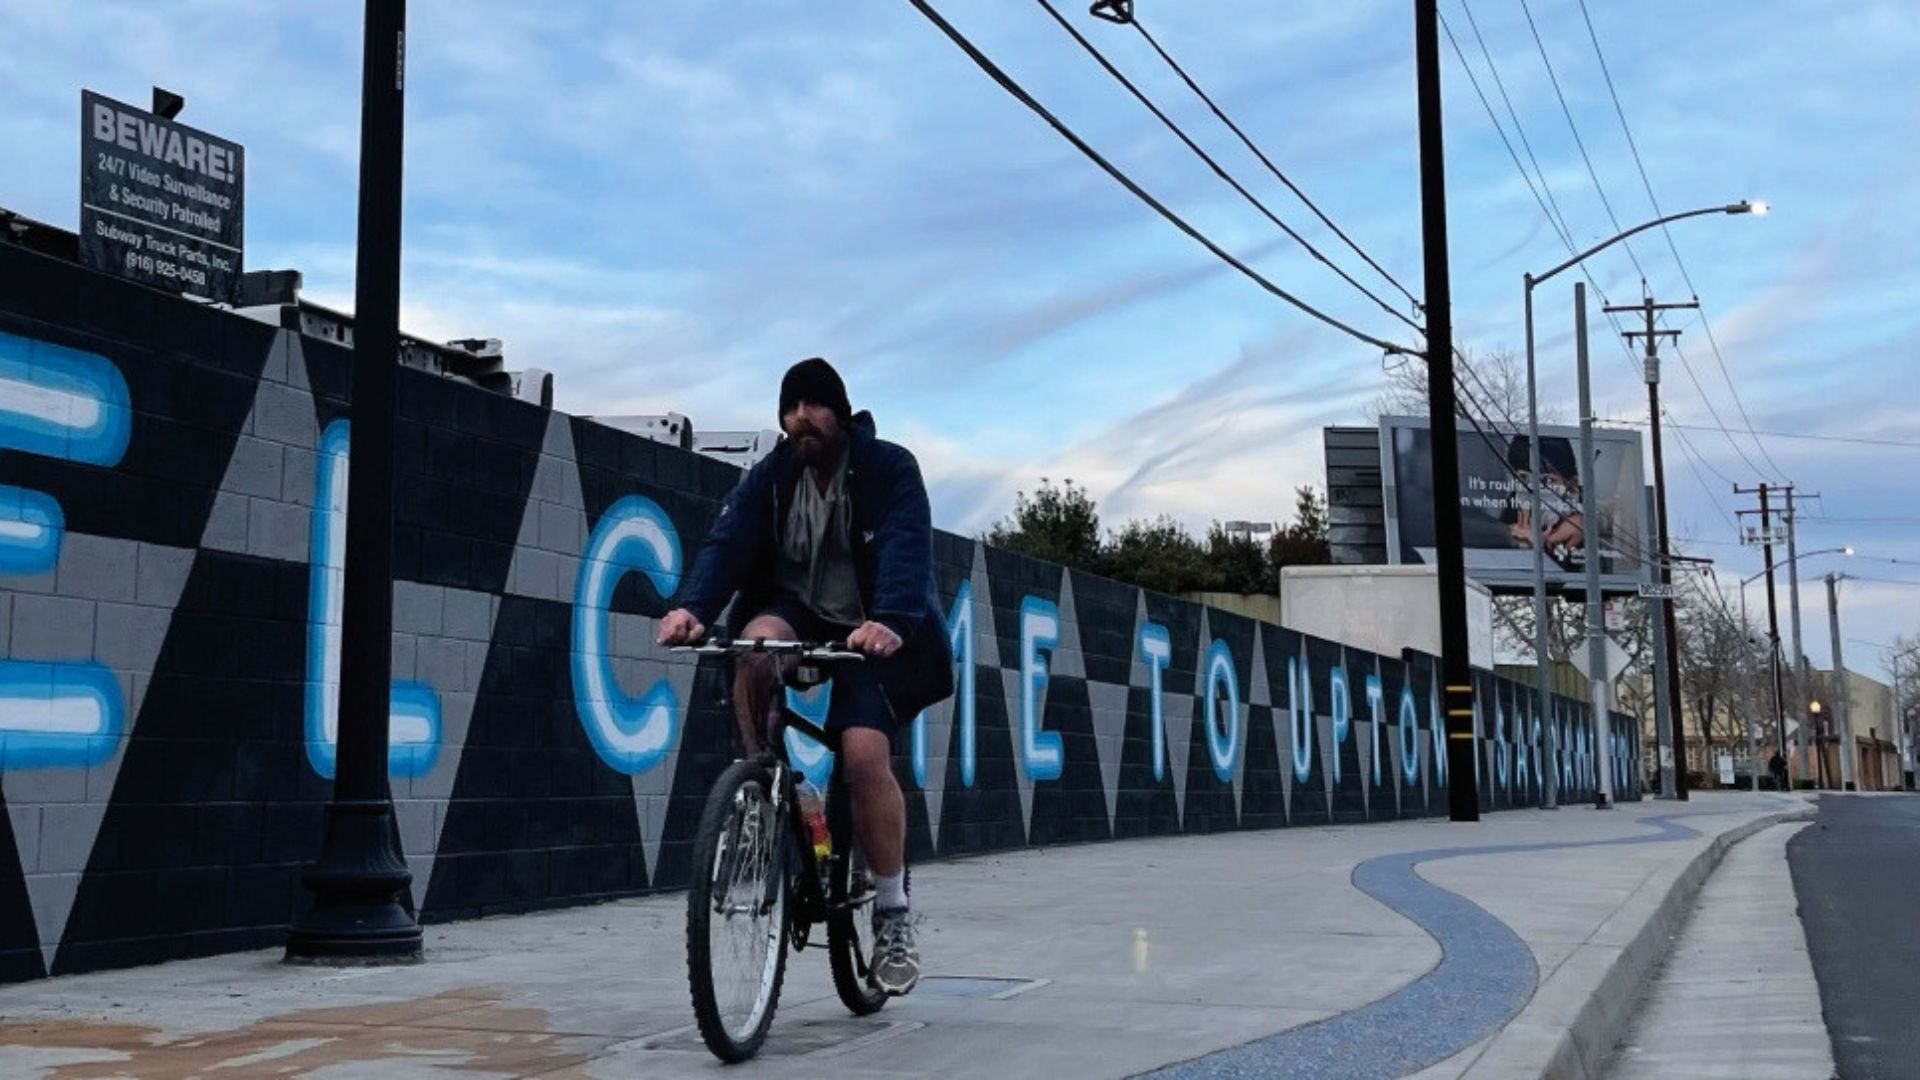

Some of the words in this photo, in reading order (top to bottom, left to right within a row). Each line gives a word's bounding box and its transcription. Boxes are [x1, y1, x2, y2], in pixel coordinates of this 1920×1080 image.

[93, 102, 235, 184] BEWARE!
[98, 152, 126, 176] 24/7
[128, 161, 160, 188] Video
[163, 173, 231, 210] Surveillance
[109, 184, 119, 201] &
[122, 186, 169, 220] Security
[172, 202, 220, 233] Patrolled
[96, 220, 142, 249] Subway
[145, 233, 176, 257] Truck
[178, 244, 210, 269] Parts,
[212, 254, 232, 272] Inc.
[126, 251, 154, 275] (916)
[1468, 475, 1486, 490] It's
[1473, 494, 1508, 508] when
[1138, 621, 1243, 784] TO
[1288, 655, 1479, 790] UPTOW
